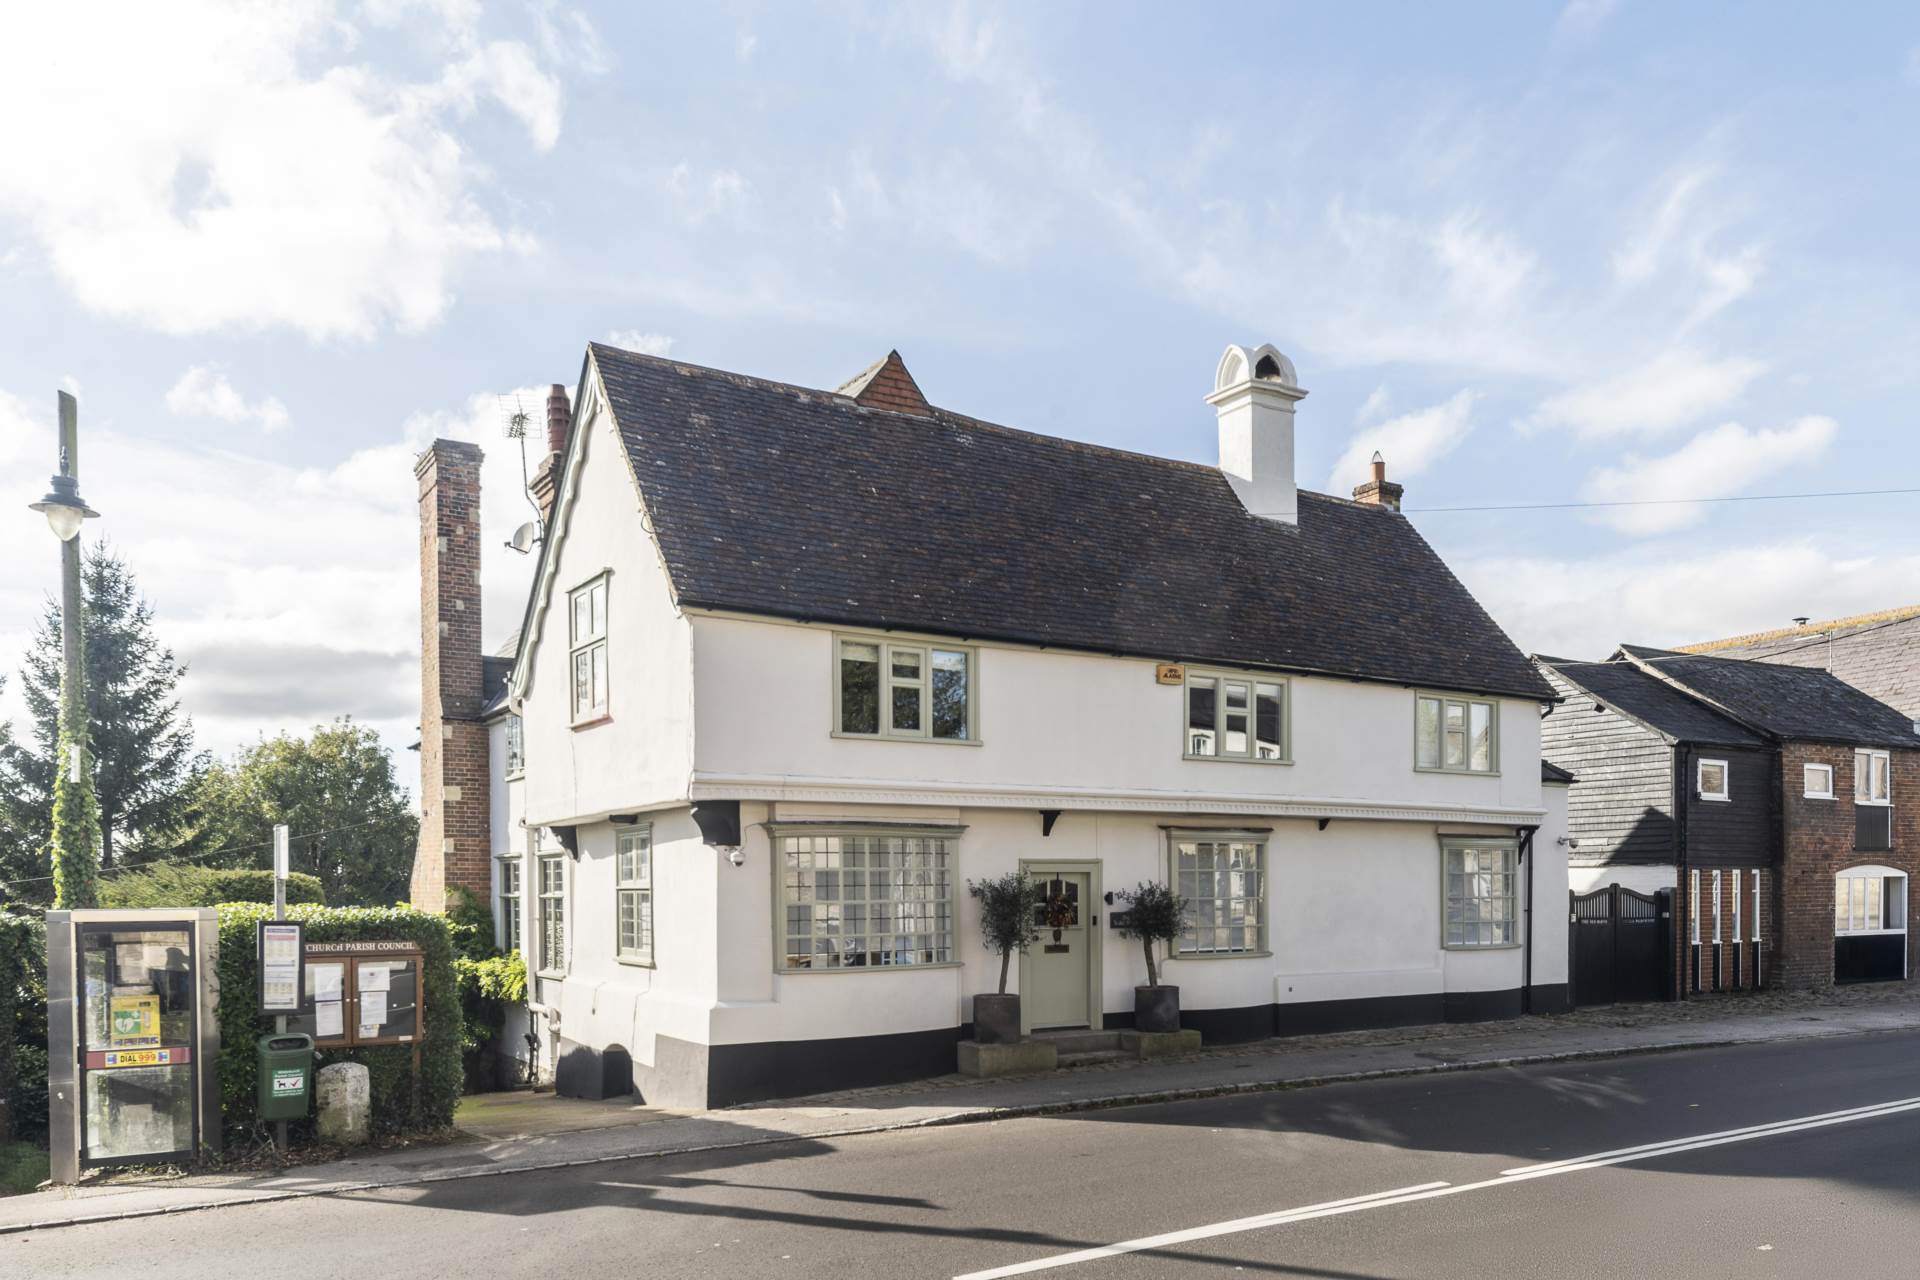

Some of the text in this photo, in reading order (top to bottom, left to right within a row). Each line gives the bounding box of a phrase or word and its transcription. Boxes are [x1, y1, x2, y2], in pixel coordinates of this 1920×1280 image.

[305, 942, 415, 952] CHURCH PARISH COUNCIL
[120, 1055, 137, 1063] DIAL
[138, 1053, 156, 1062] 999
